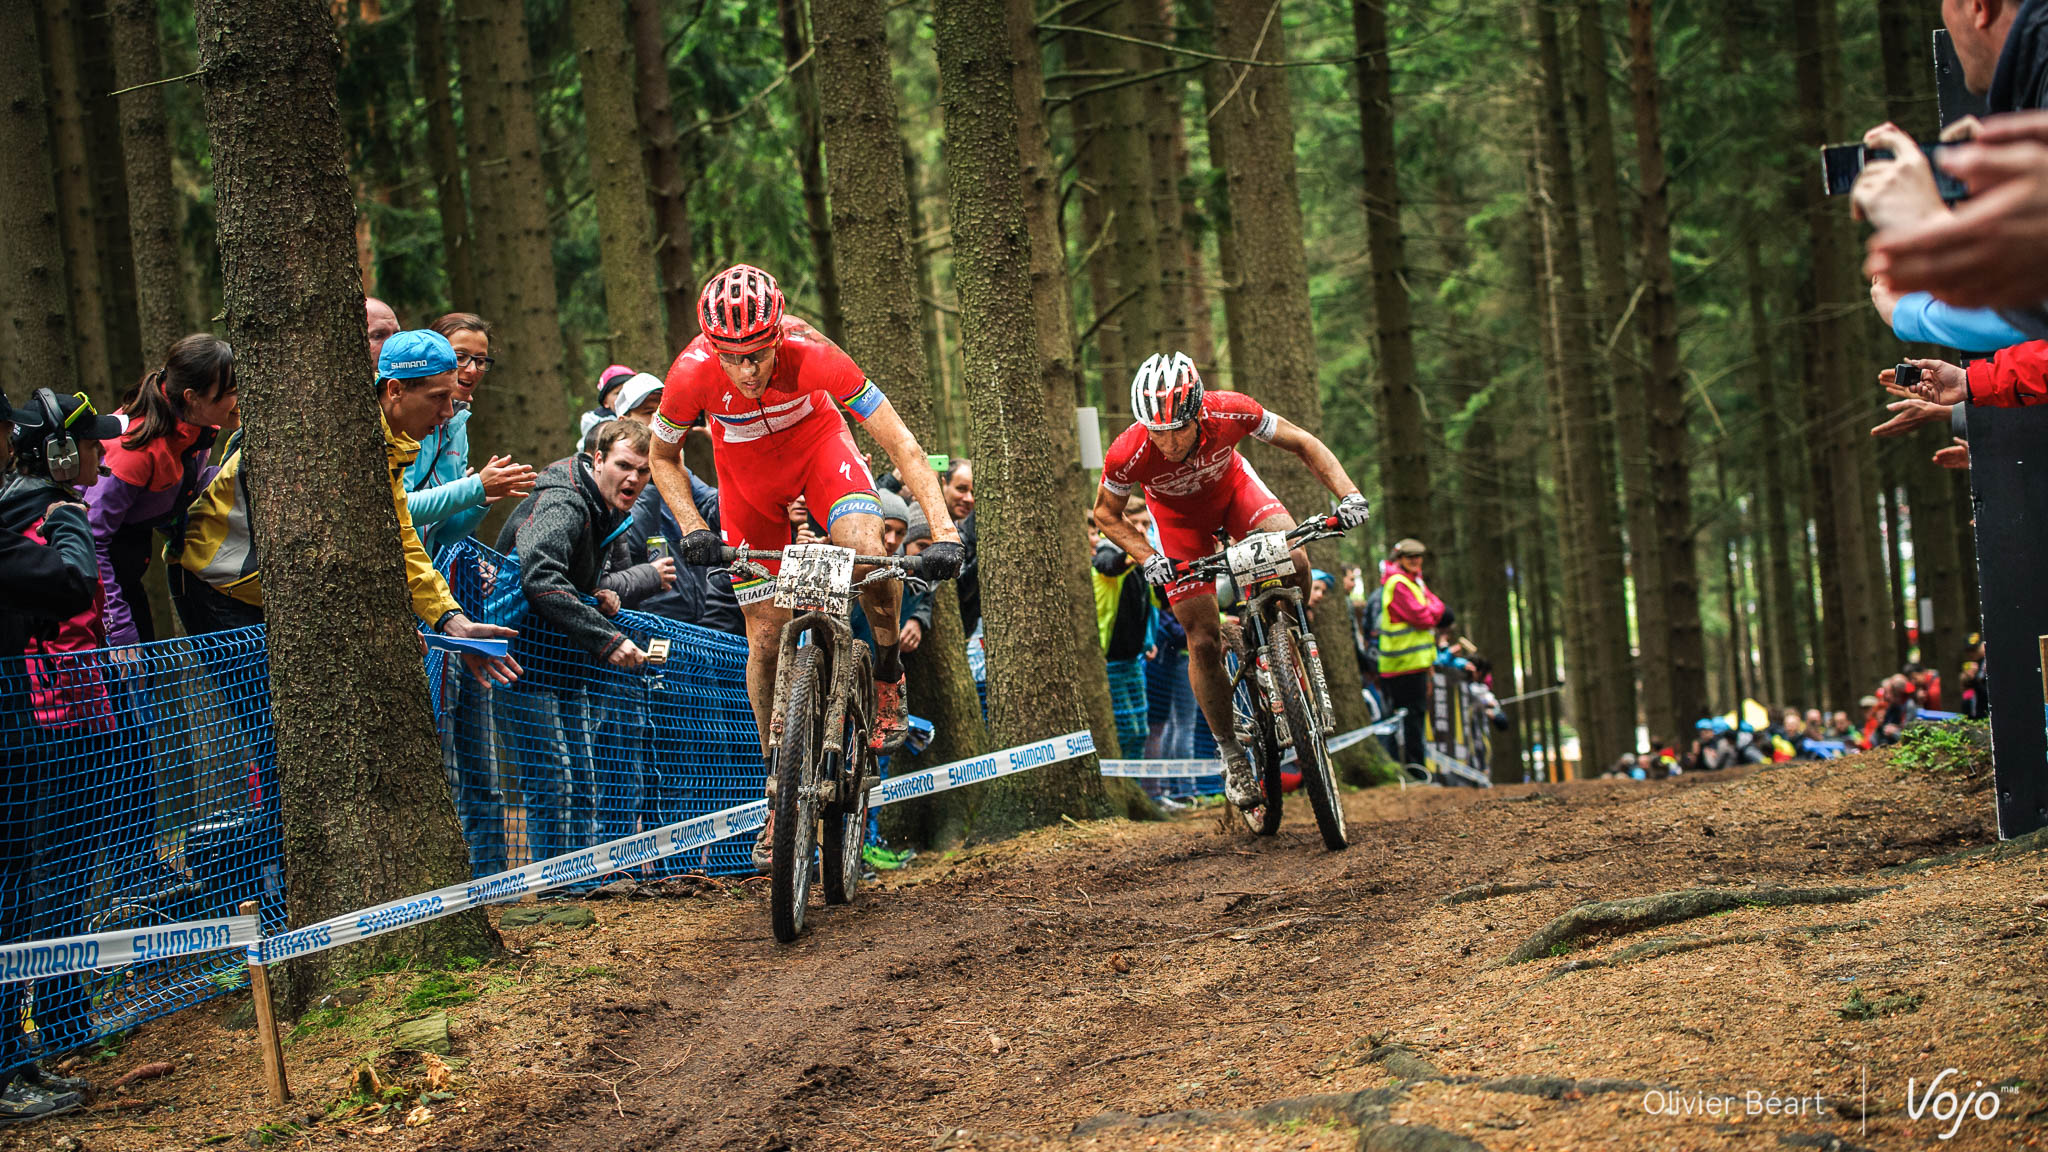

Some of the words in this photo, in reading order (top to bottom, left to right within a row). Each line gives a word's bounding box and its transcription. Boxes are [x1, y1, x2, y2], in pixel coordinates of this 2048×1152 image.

[391, 360, 428, 370] SHIMANO
[1211, 411, 1258, 421] SCOTT
[1250, 541, 1267, 565] 2
[1009, 743, 1056, 771] SHIMANO
[948, 758, 997, 786] SHIMANO
[881, 773, 935, 802] SHIMANO
[671, 818, 717, 851] SHIMANO
[609, 835, 660, 869] SHIMANO
[541, 852, 598, 886] SHIMANO
[467, 872, 529, 904] SHIMANO
[356, 895, 445, 936] SHIMANO
